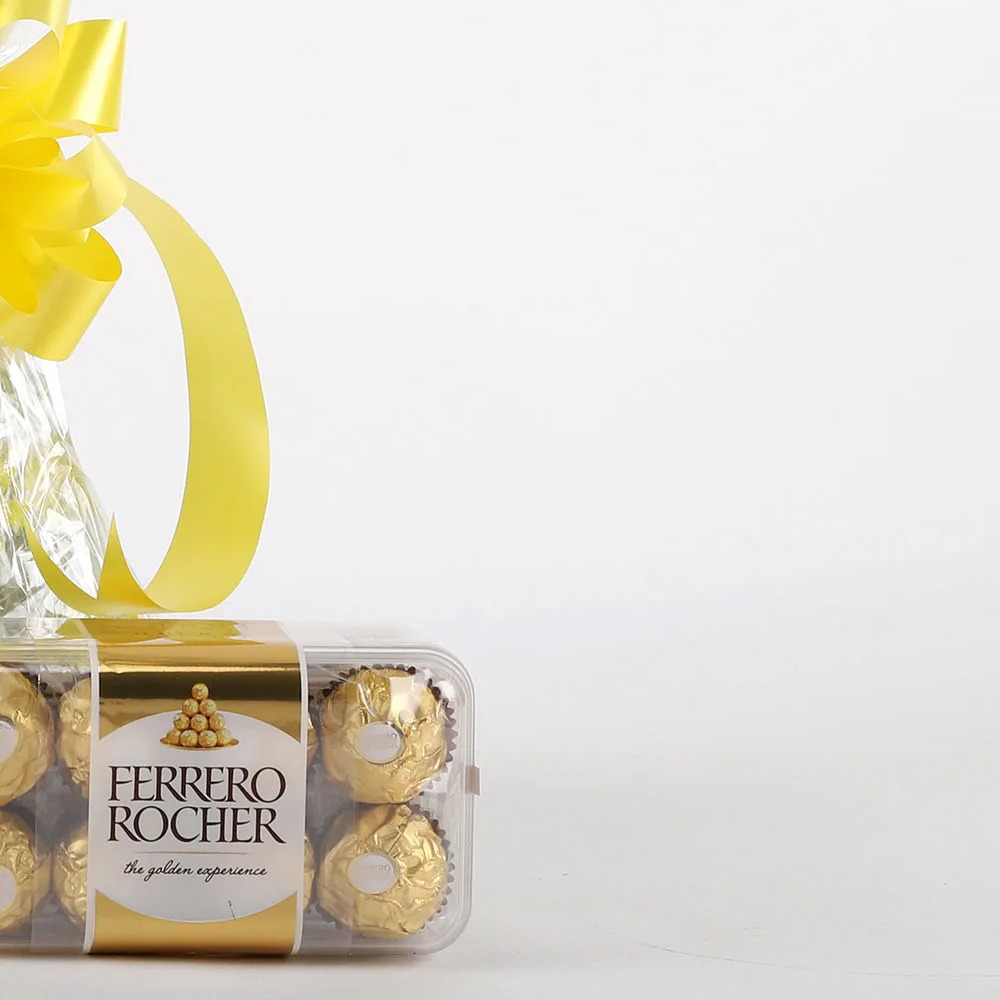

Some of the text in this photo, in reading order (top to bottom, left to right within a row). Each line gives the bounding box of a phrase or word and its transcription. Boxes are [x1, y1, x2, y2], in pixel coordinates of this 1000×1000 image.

[108, 765, 287, 803] FERRERO
[107, 805, 287, 844] ROCHER
[123, 860, 268, 882] the golden experience
